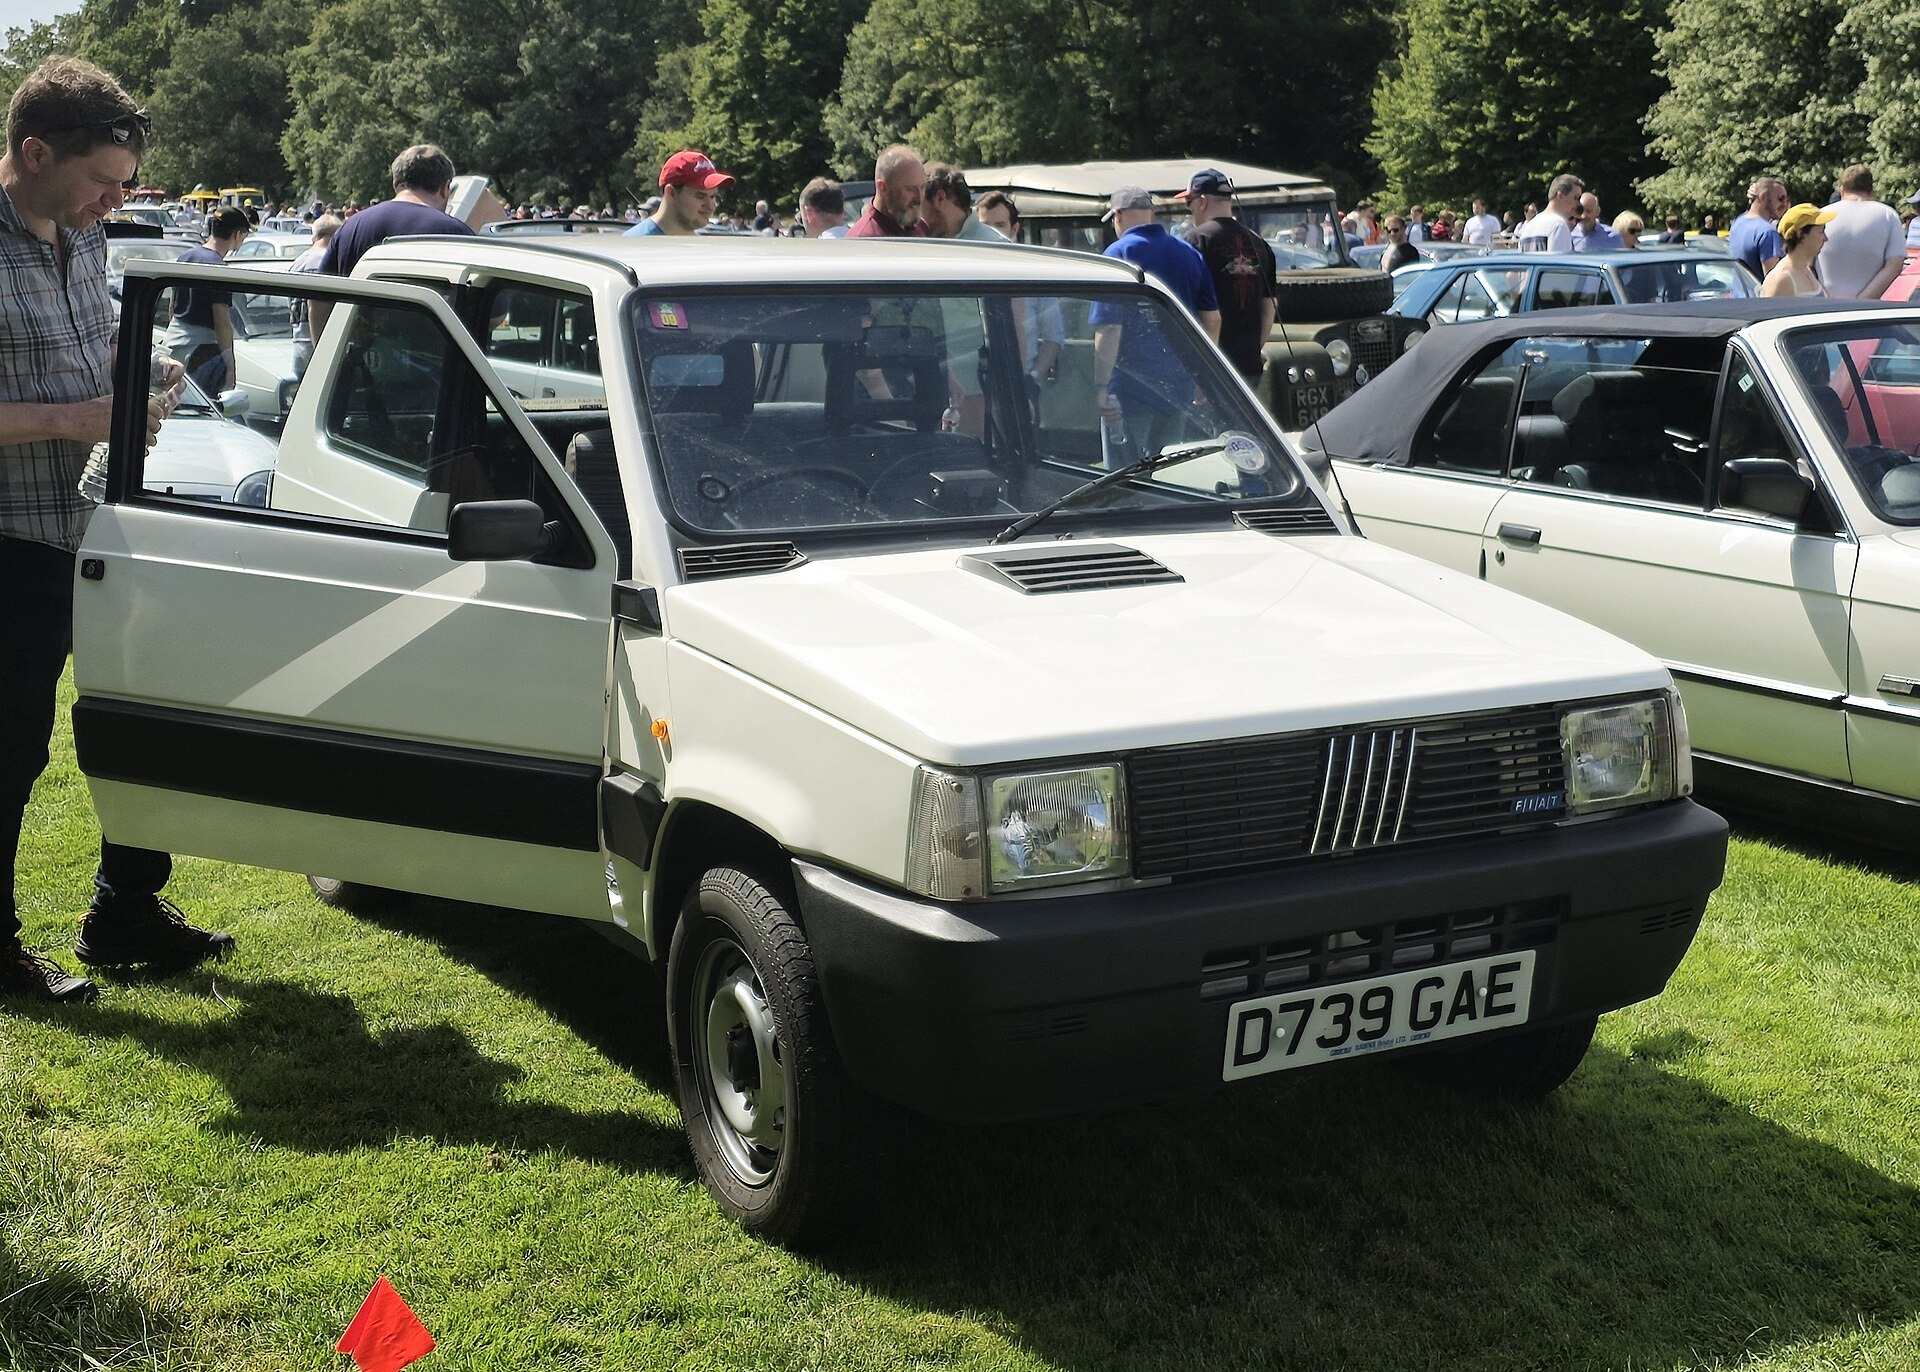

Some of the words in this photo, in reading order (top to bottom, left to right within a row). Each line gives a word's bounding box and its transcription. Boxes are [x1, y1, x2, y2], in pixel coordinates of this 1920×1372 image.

[1296, 386, 1328, 407] RGX
[1233, 986, 1395, 1067] D739
[1408, 961, 1522, 1032] GAE
